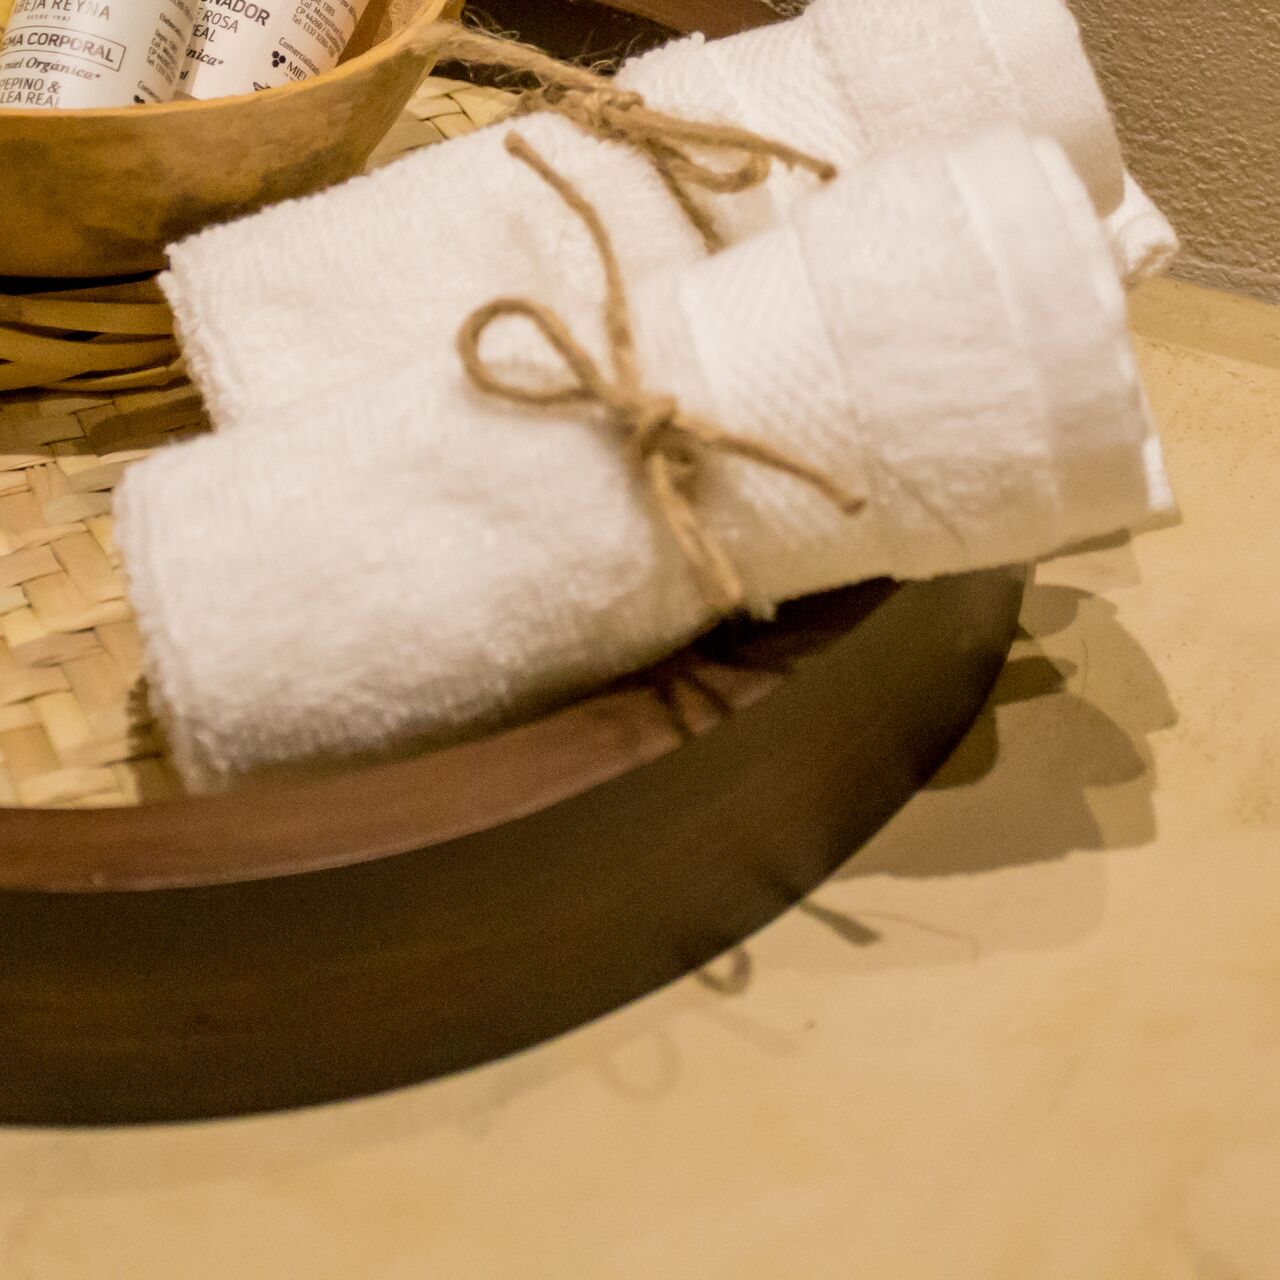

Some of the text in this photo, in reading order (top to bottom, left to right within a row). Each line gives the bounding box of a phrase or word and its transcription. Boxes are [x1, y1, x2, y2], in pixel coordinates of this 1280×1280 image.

[202, 7, 240, 34] ROSA
[27, 32, 115, 64] CORPORAL
[47, 80, 63, 96] &
